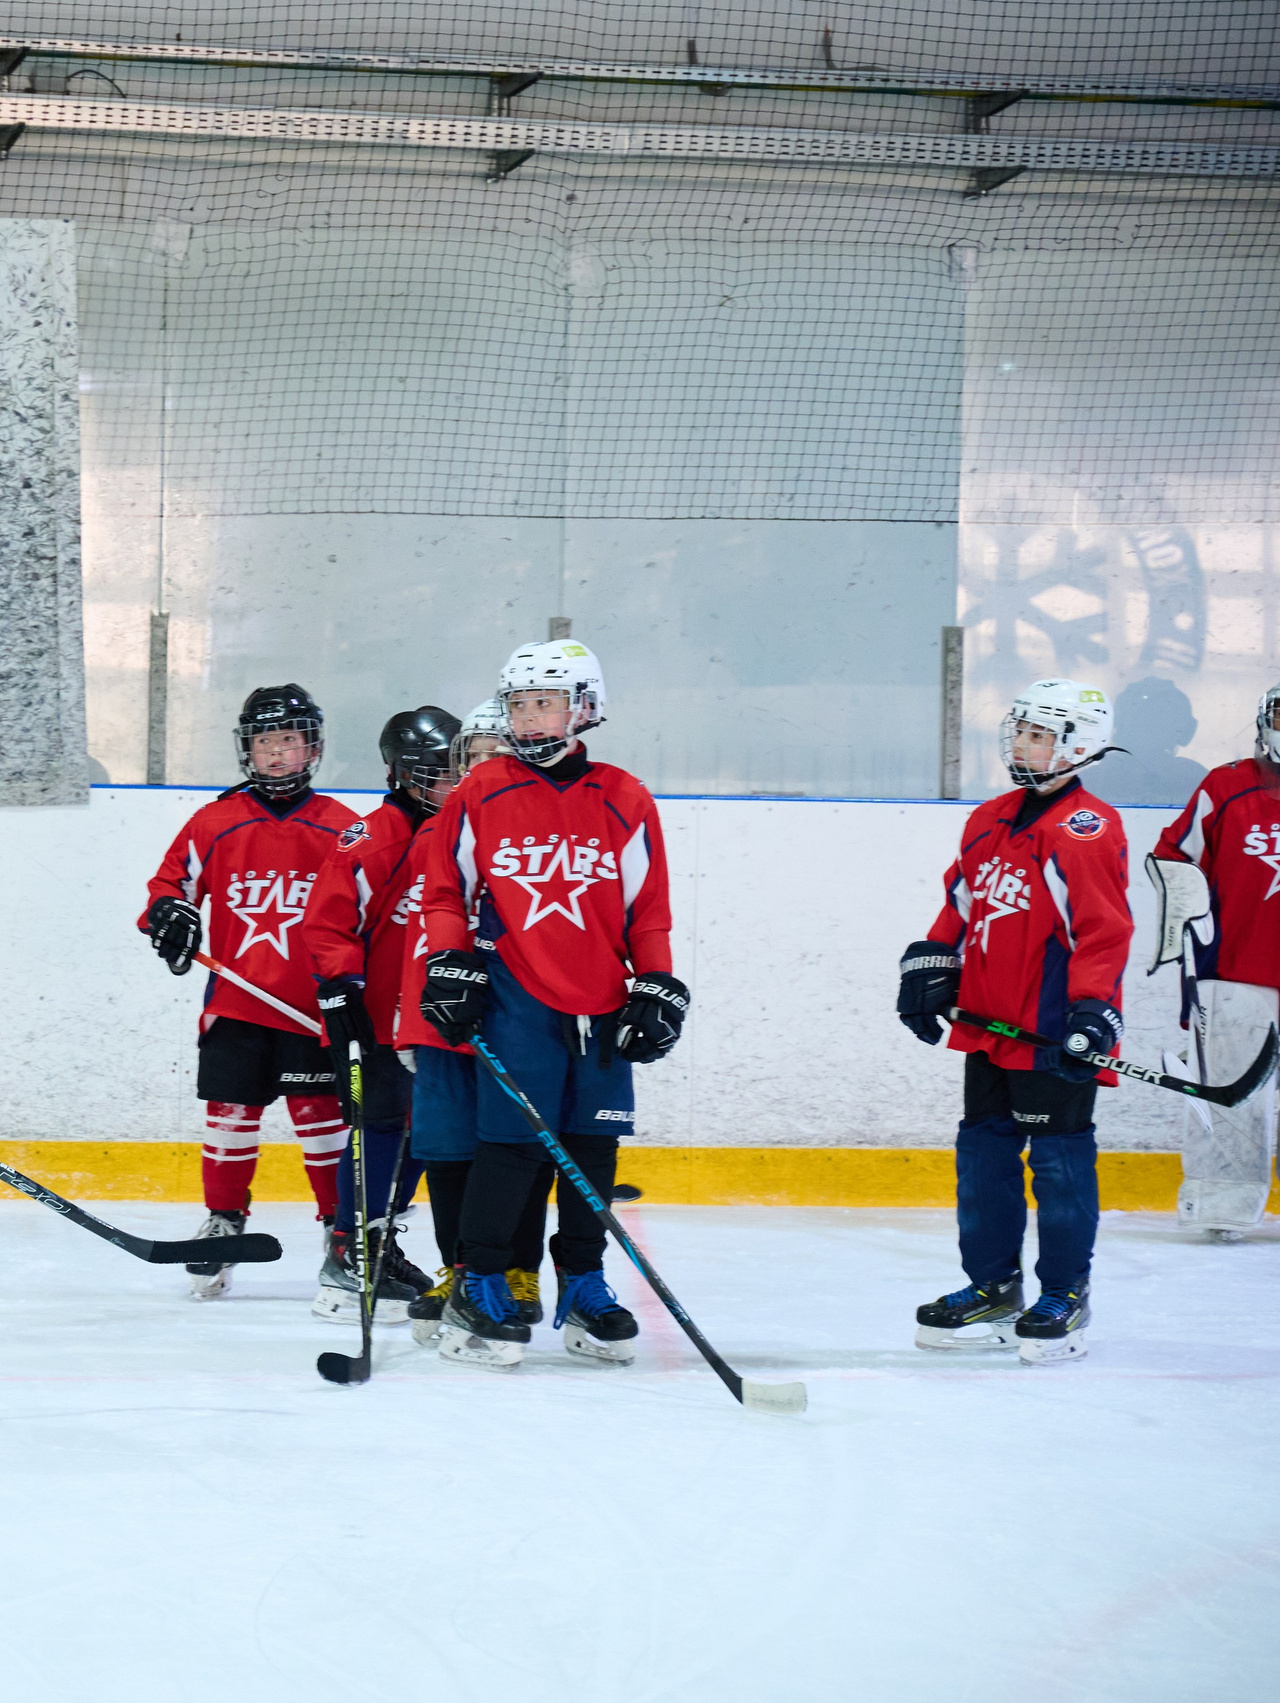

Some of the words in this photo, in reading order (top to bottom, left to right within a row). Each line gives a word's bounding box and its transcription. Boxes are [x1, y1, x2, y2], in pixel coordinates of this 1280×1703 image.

[499, 834, 600, 848] BOSTO
[489, 839, 619, 880] STARS
[230, 870, 318, 882] BOSTO
[226, 876, 314, 909] STAR
[428, 966, 489, 985] BAUE
